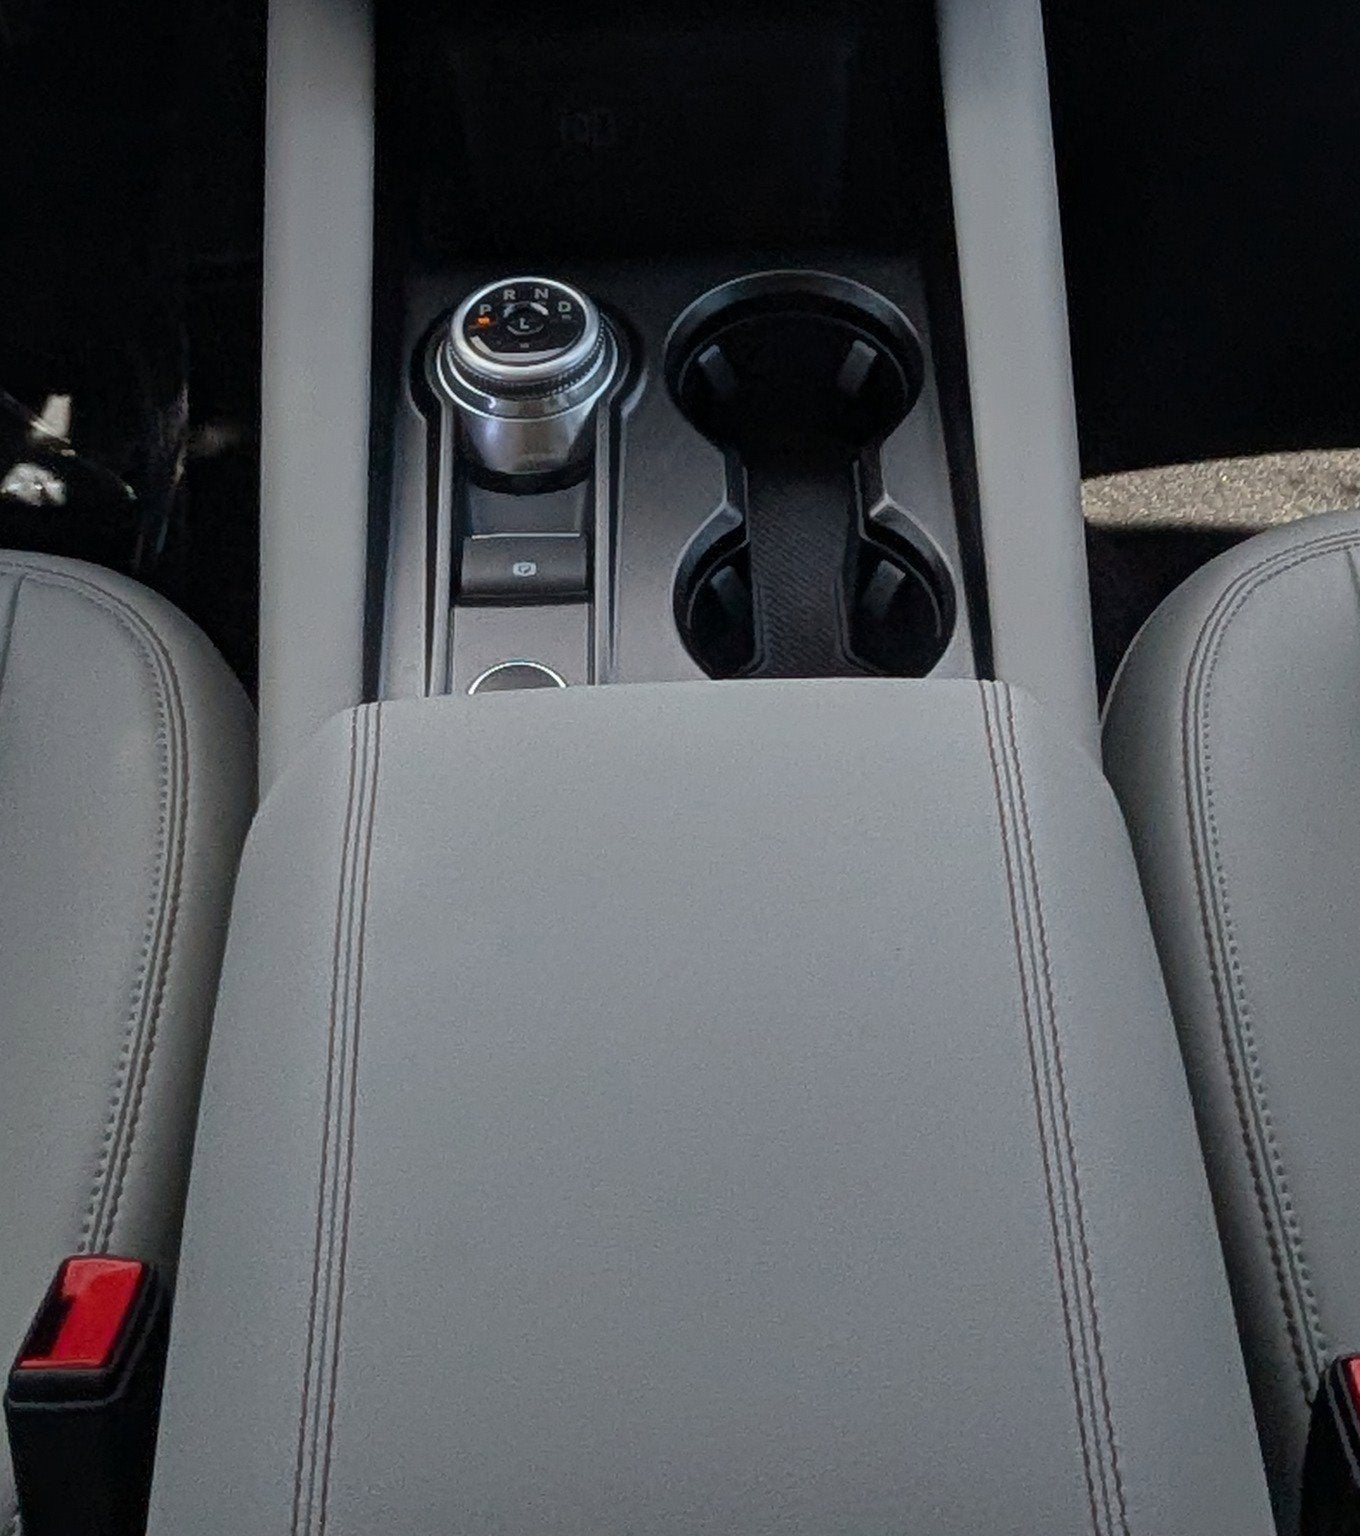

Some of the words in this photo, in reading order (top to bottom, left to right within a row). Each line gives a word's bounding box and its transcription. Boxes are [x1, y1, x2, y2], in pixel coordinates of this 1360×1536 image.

[479, 303, 493, 315] P
[503, 289, 516, 301] R
[534, 288, 549, 299] N
[557, 301, 572, 313] D
[519, 317, 530, 329] L
